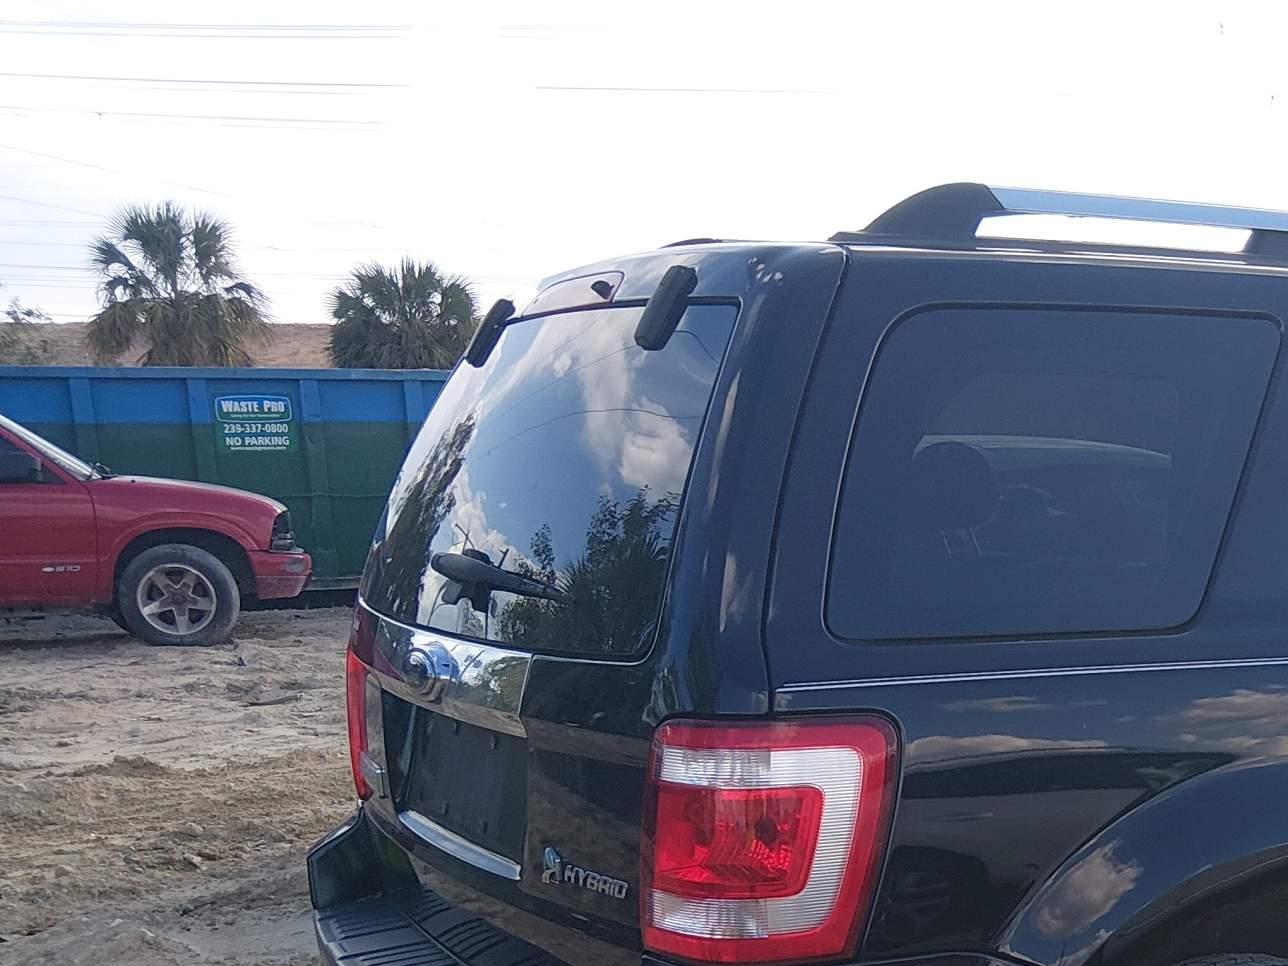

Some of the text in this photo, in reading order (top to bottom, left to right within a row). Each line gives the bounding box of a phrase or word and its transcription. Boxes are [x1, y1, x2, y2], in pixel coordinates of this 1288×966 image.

[221, 400, 285, 412] WASTE PRO
[223, 423, 289, 433] 239-337-0800
[225, 436, 290, 446] NO PARKING
[564, 864, 629, 900] HYBRID
